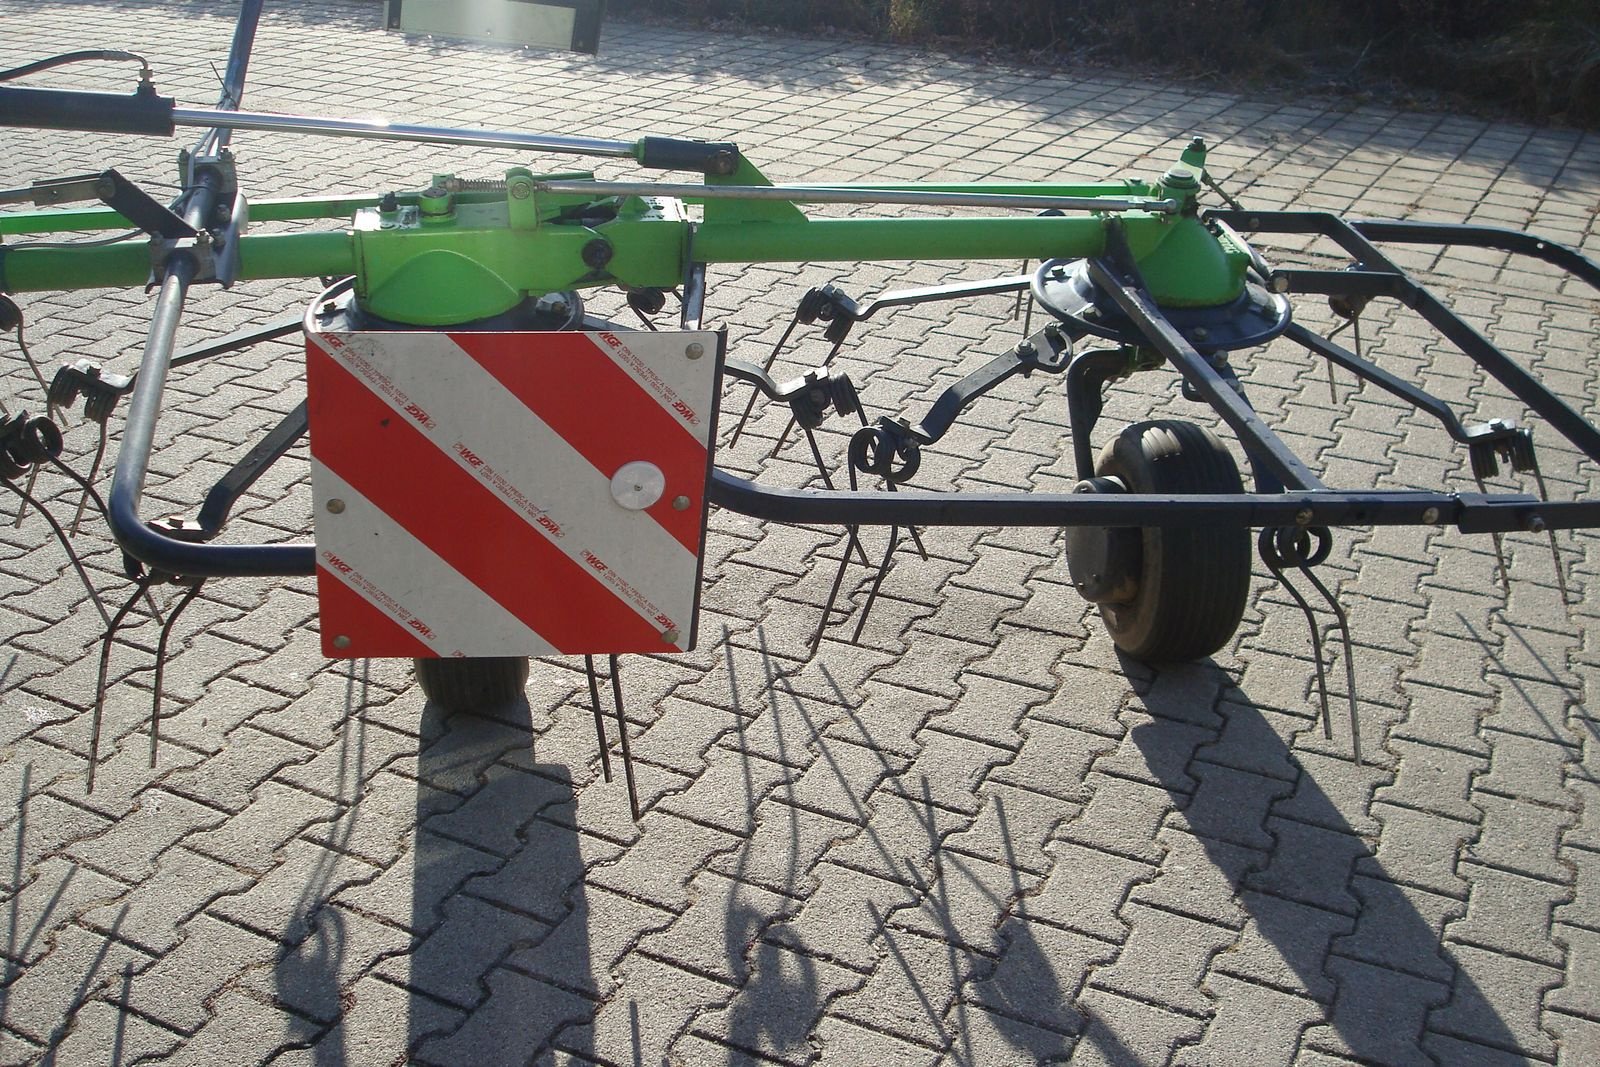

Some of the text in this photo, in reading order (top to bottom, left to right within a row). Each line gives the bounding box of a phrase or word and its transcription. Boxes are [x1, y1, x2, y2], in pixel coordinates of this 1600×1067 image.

[404, 403, 430, 424] WGF
[672, 401, 694, 421] WGF
[460, 448, 484, 467] WGF
[536, 516, 560, 534] WGF
[329, 556, 353, 574] WGF
[586, 554, 608, 571] WGF
[407, 618, 431, 636] WGF
[654, 614, 676, 631] WGF
